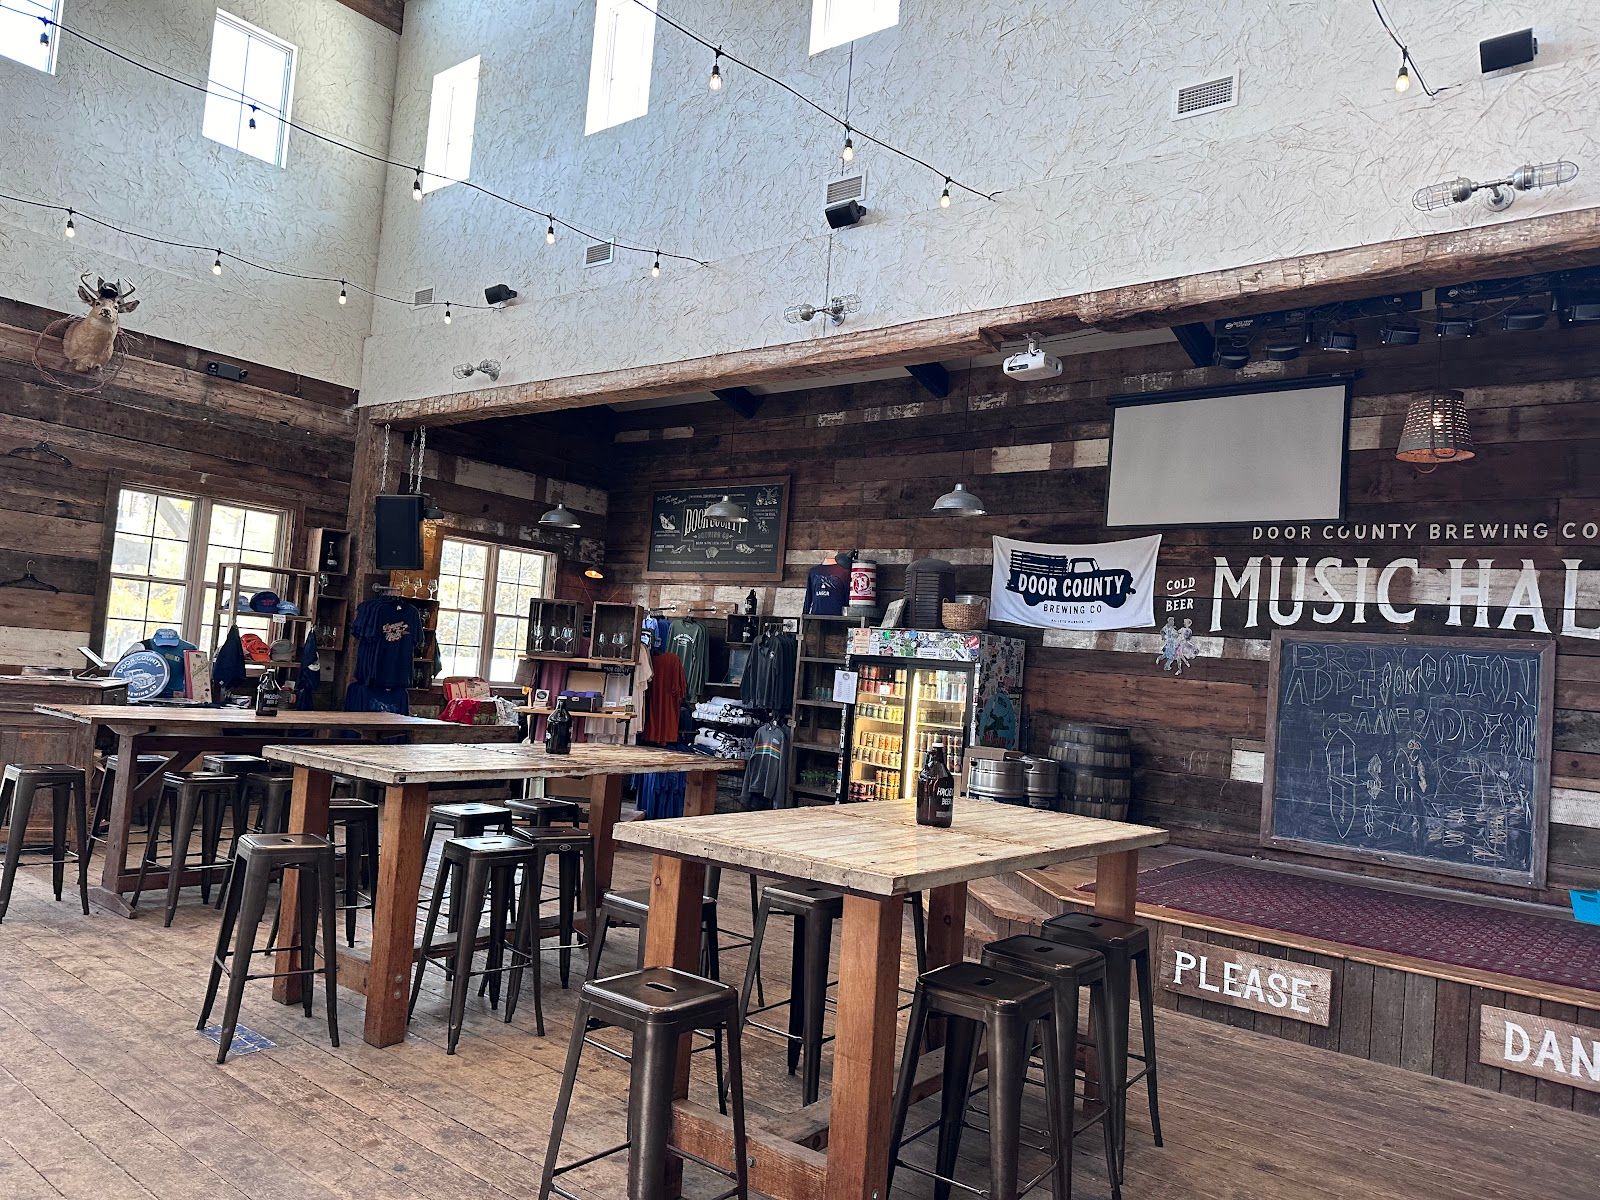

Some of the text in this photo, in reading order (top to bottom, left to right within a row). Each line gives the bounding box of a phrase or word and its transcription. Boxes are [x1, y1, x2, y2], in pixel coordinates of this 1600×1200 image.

[1252, 522, 1599, 540] DOOR COUNTY BREWING CO
[1018, 573, 1125, 598] DOOR COUNTY
[1166, 577, 1196, 591] COLD
[1209, 556, 1419, 632] MUSIC
[1043, 603, 1102, 615] BREWING CO
[1165, 598, 1194, 612] BEER
[117, 659, 135, 673] DOOR
[136, 655, 162, 668] COUNTY
[1172, 950, 1312, 1014] PLEASE
[1503, 1020, 1600, 1082] DAN
